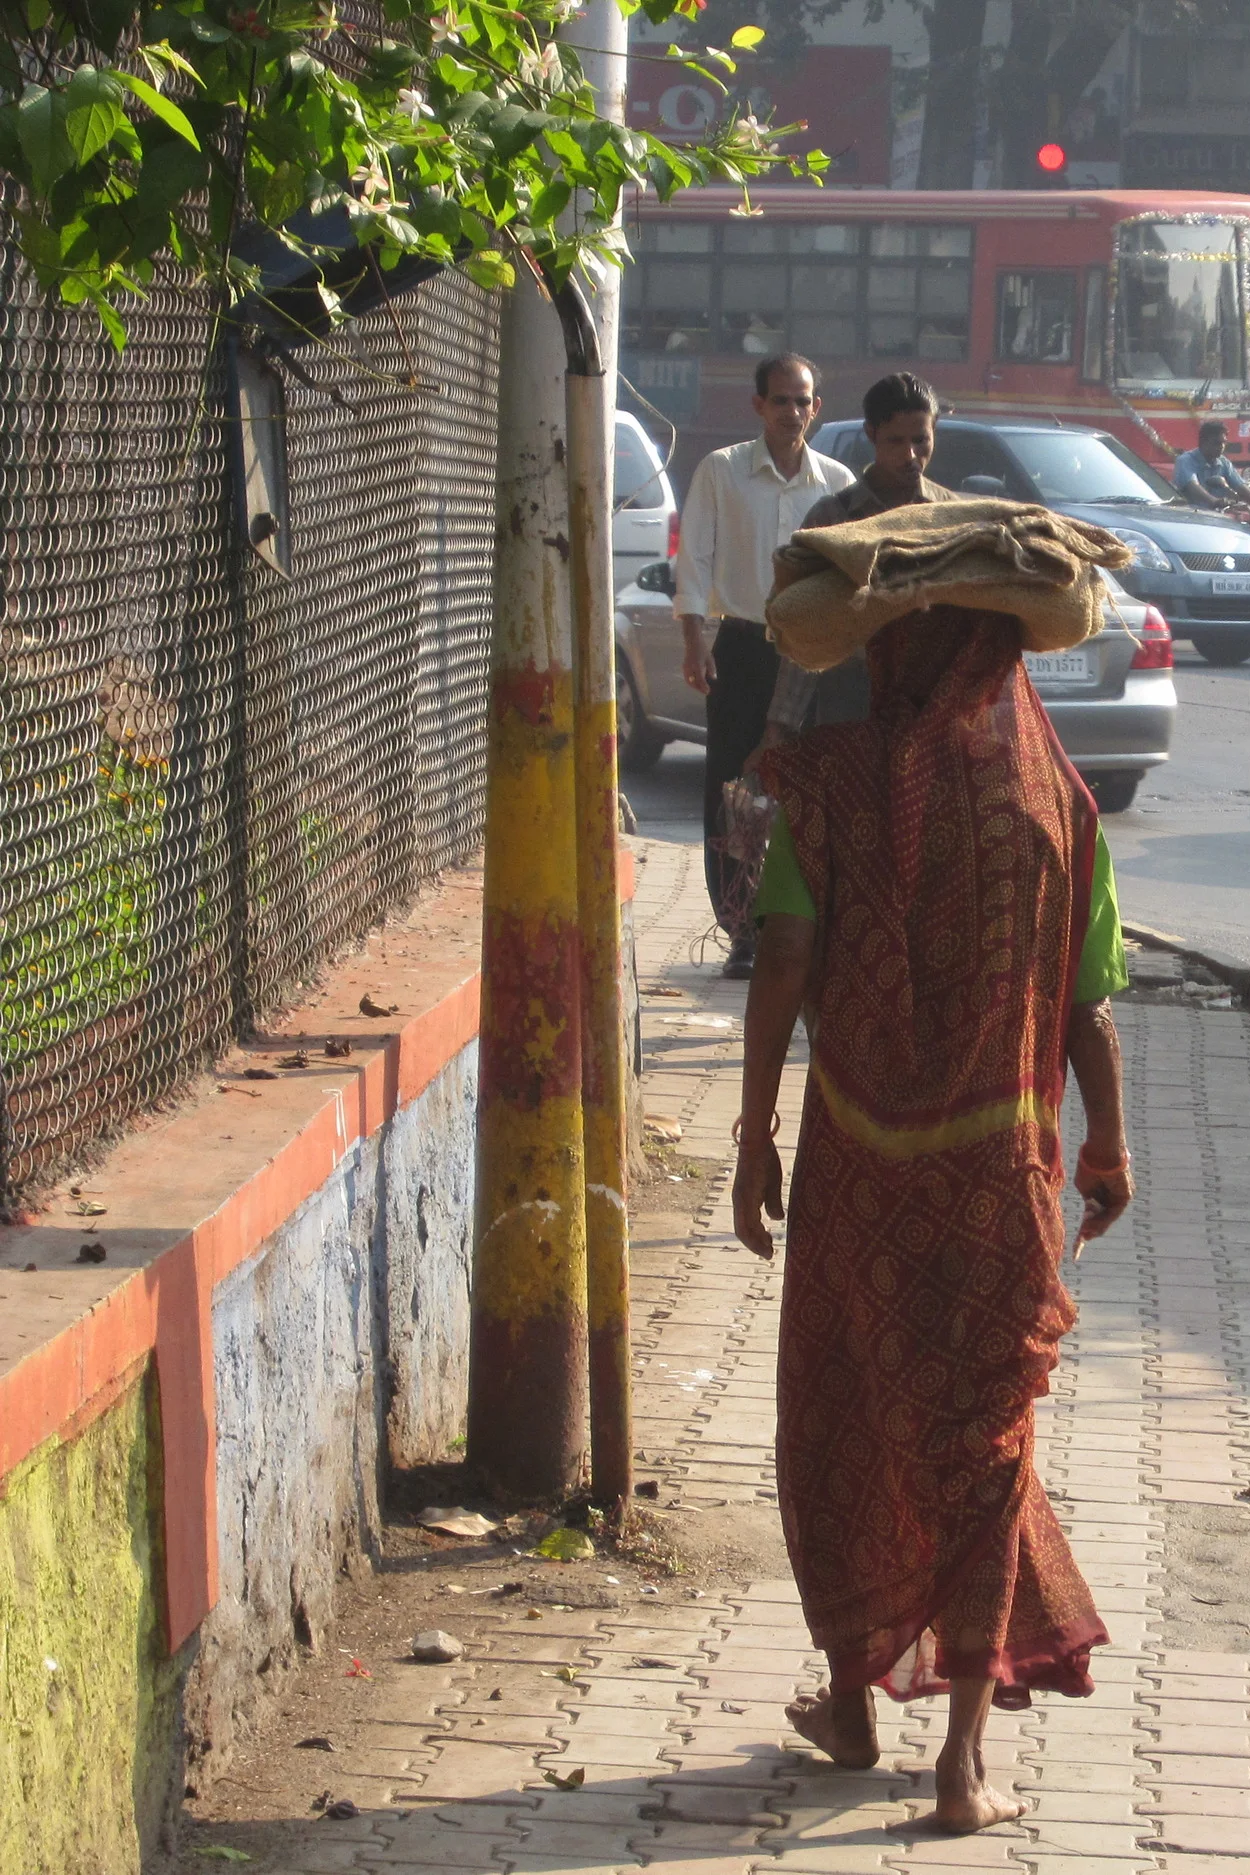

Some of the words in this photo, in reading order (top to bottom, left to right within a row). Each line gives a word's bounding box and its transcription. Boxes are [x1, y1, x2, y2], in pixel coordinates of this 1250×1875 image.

[1211, 402, 1242, 411] ASHOK
[1036, 658, 1054, 672] DY
[1056, 658, 1084, 672] 1577
